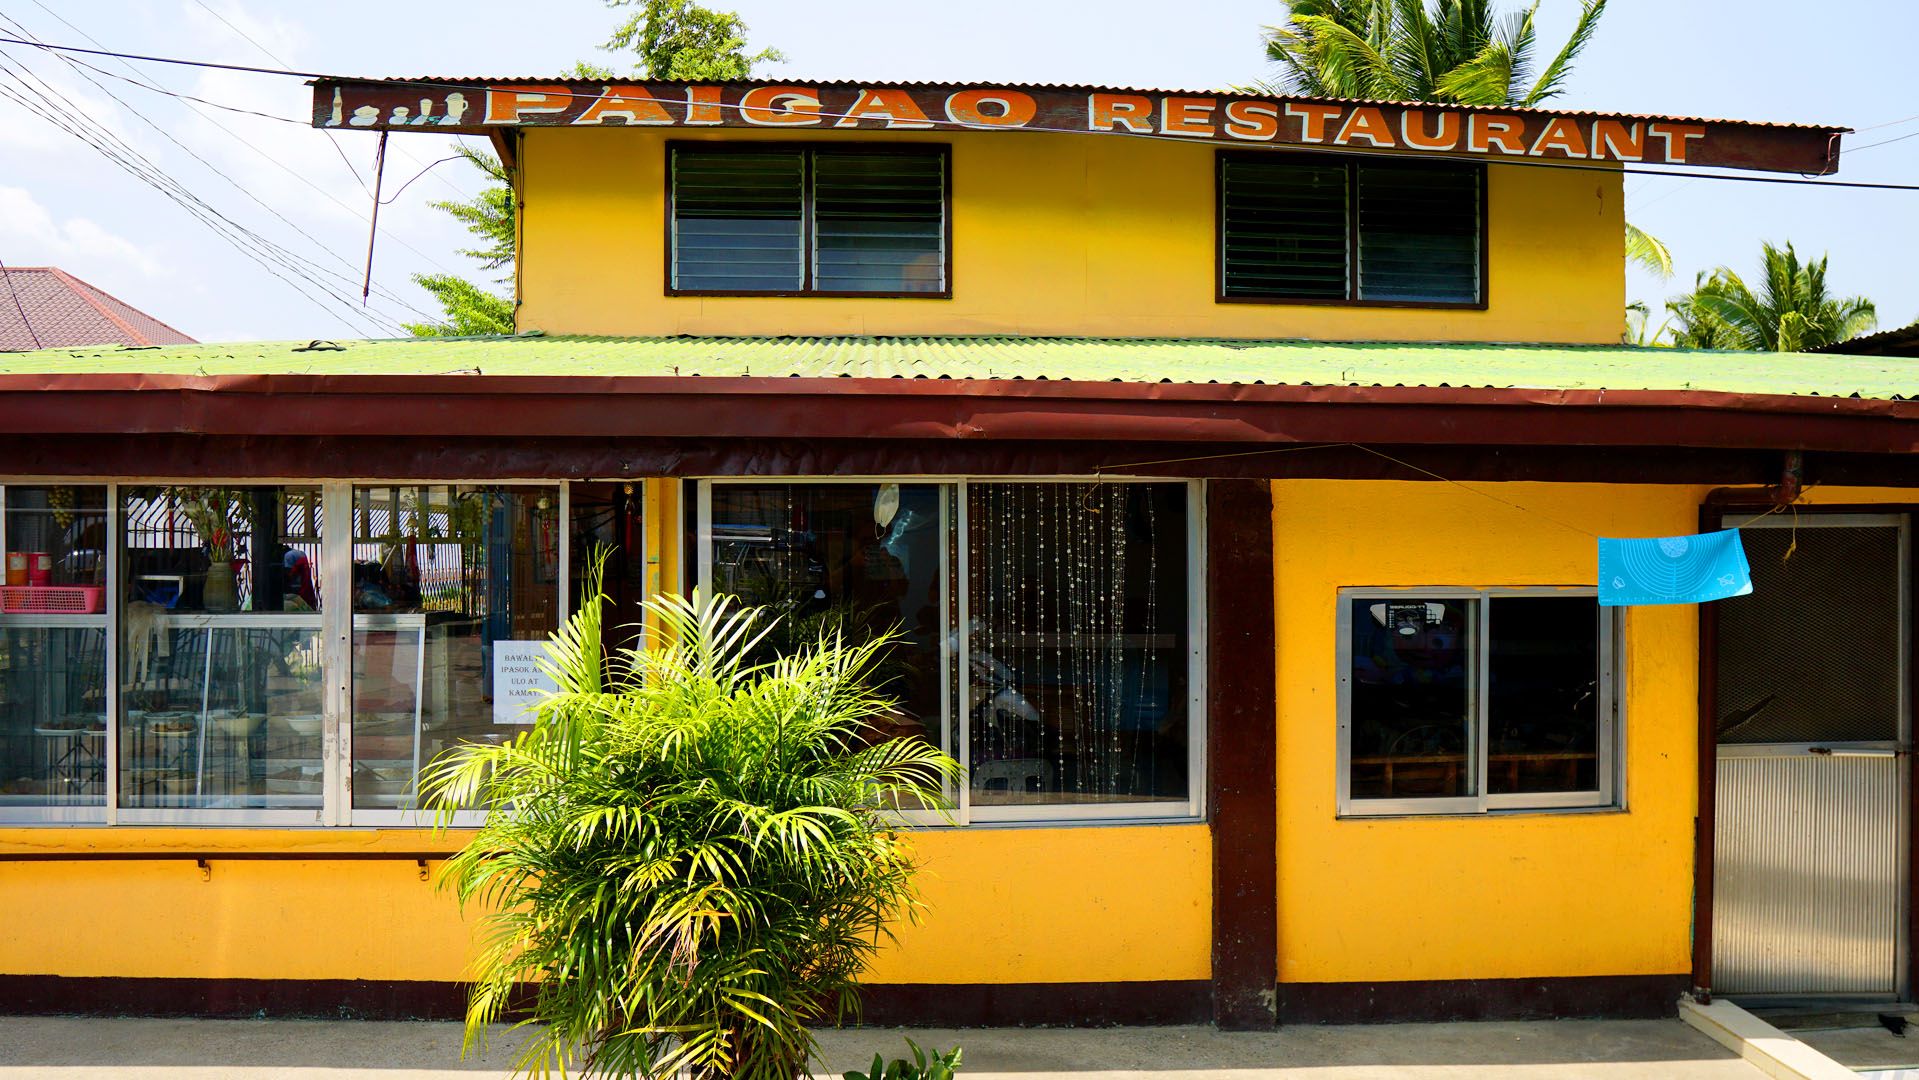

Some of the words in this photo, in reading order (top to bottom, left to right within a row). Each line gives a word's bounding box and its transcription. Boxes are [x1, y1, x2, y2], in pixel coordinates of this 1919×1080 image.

[483, 85, 1037, 130] PAIGAO
[1088, 93, 1706, 163] RESTAURANT
[504, 654, 533, 662] BAWAL
